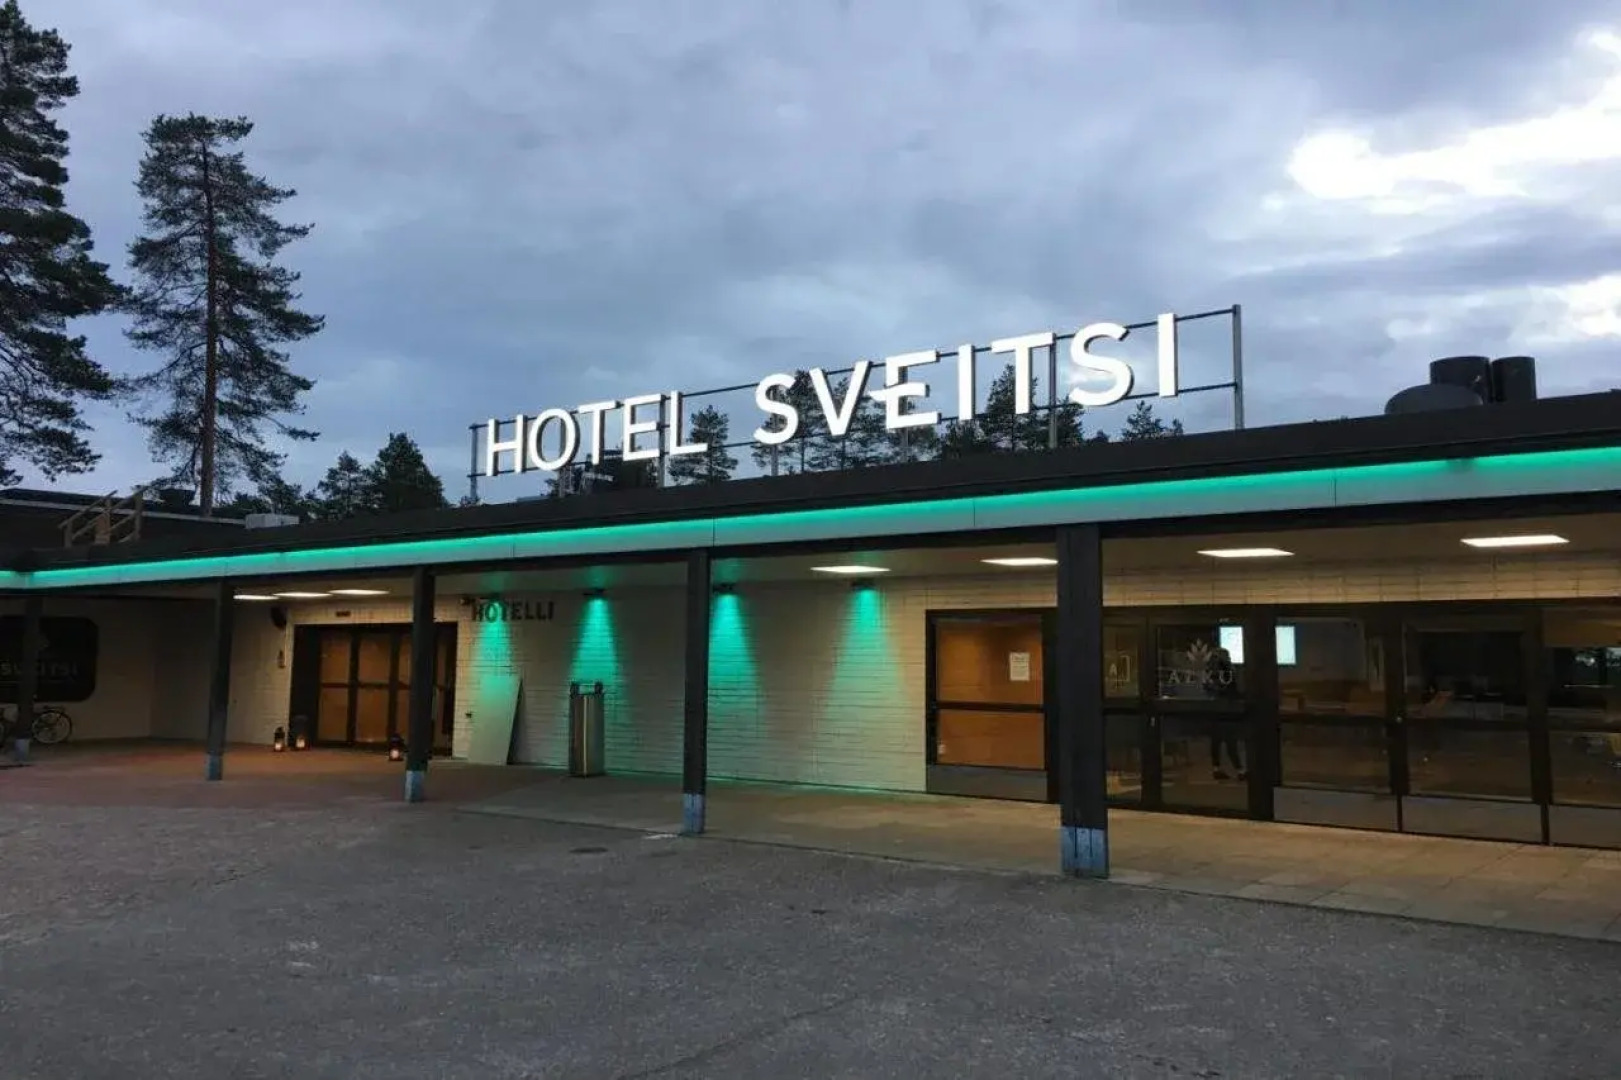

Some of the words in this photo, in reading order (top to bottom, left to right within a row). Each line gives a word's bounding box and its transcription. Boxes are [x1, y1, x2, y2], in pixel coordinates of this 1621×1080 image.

[486, 391, 709, 477] HOTEL
[753, 312, 1179, 446] SVEITSI
[472, 601, 554, 622] HOTELLI
